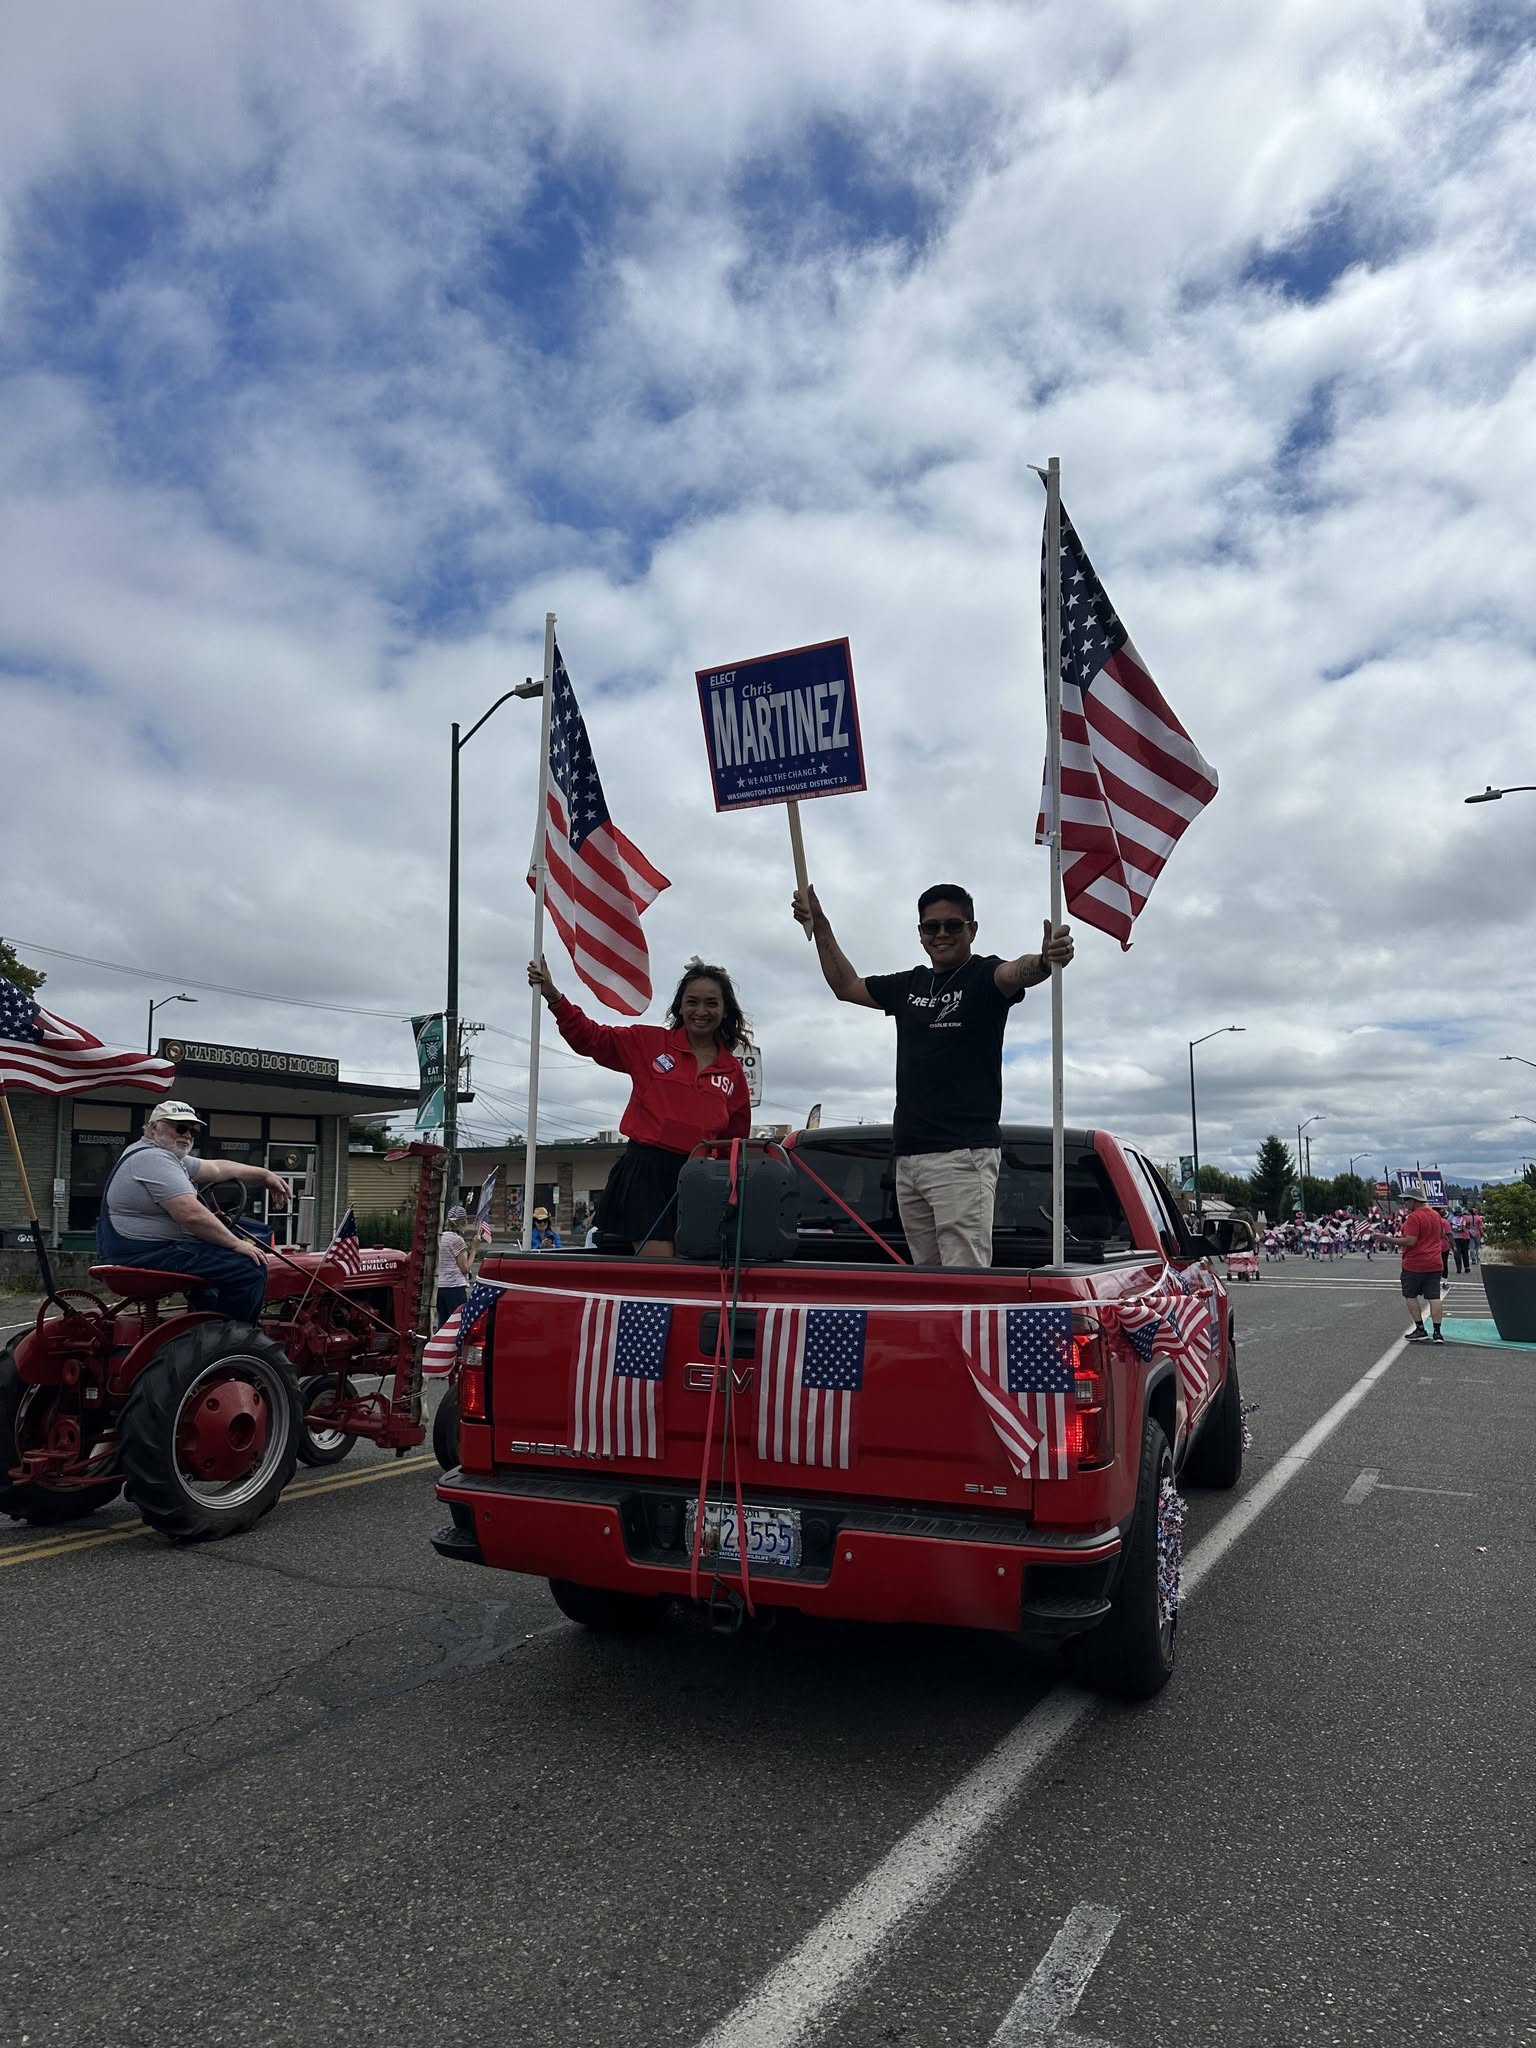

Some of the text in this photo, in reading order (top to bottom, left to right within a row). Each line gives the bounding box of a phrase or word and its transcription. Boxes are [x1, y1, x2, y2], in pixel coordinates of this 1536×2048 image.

[710, 671, 736, 687] ELECT
[742, 682, 773, 698] Chris
[711, 680, 849, 769] MARTINEZ
[748, 767, 817, 785] WE ARE THE CHANGE
[727, 789, 767, 800] WASHINGTON
[767, 785, 786, 794] STATE
[786, 782, 808, 791] HOUSE
[809, 777, 838, 788] DISTRICT
[907, 990, 963, 1008] FREEOM
[185, 1045, 338, 1077] MARISCOS LOS MOCHIS
[427, 1066, 440, 1076] EAT
[964, 1484, 1008, 1496] SLE
